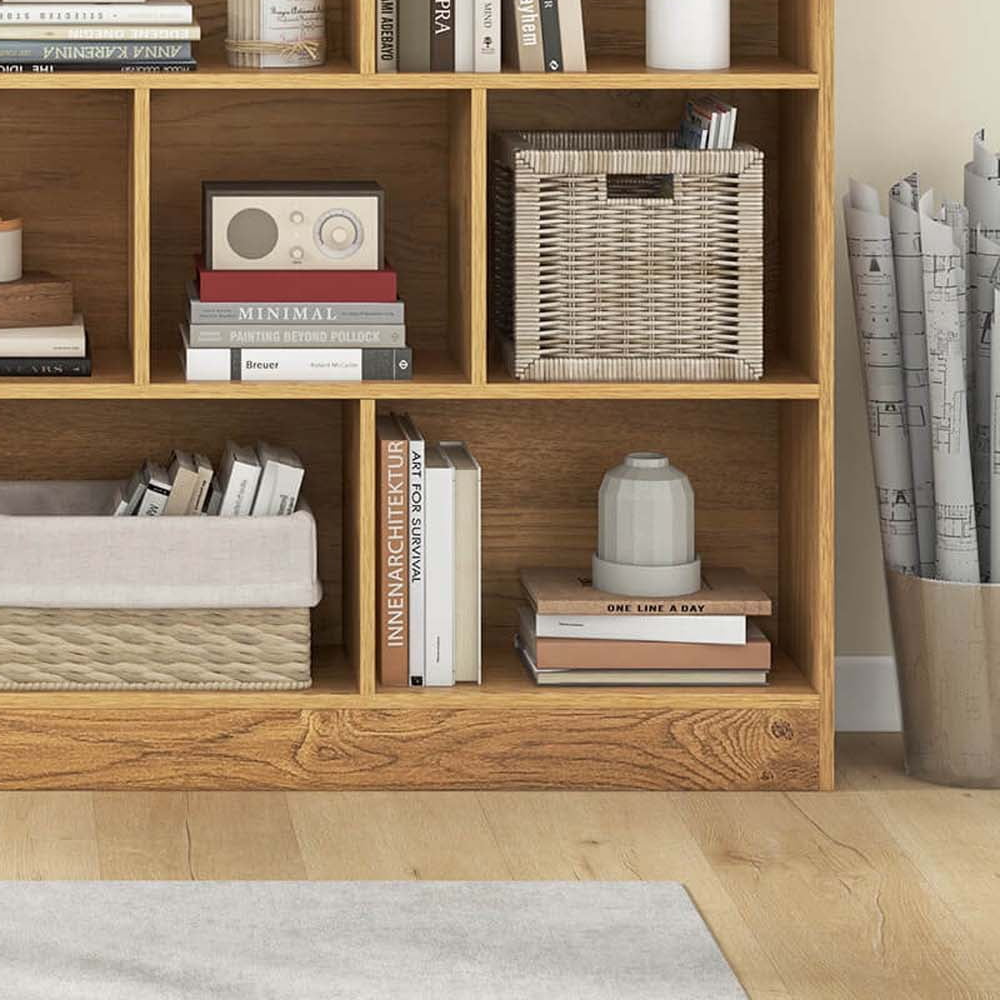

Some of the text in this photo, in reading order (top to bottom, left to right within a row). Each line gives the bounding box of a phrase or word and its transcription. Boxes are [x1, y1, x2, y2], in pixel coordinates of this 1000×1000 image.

[483, 3, 493, 29] MIND
[380, 17, 394, 61] ADEBAYO
[41, 45, 129, 58] KARENINA
[132, 44, 182, 58] ANNA
[31, 64, 54, 73] THE
[238, 307, 337, 321] MINIMAL
[230, 331, 281, 343] PAINTING
[284, 331, 328, 343] BEYOND
[331, 331, 381, 343] POLLOCK
[245, 359, 279, 369] Breuer
[411, 450, 422, 583] ART FOR SURVIVAL
[387, 439, 406, 647] INNENARCHITEKTUR
[607, 604, 705, 613] ONE LINE A DAY
